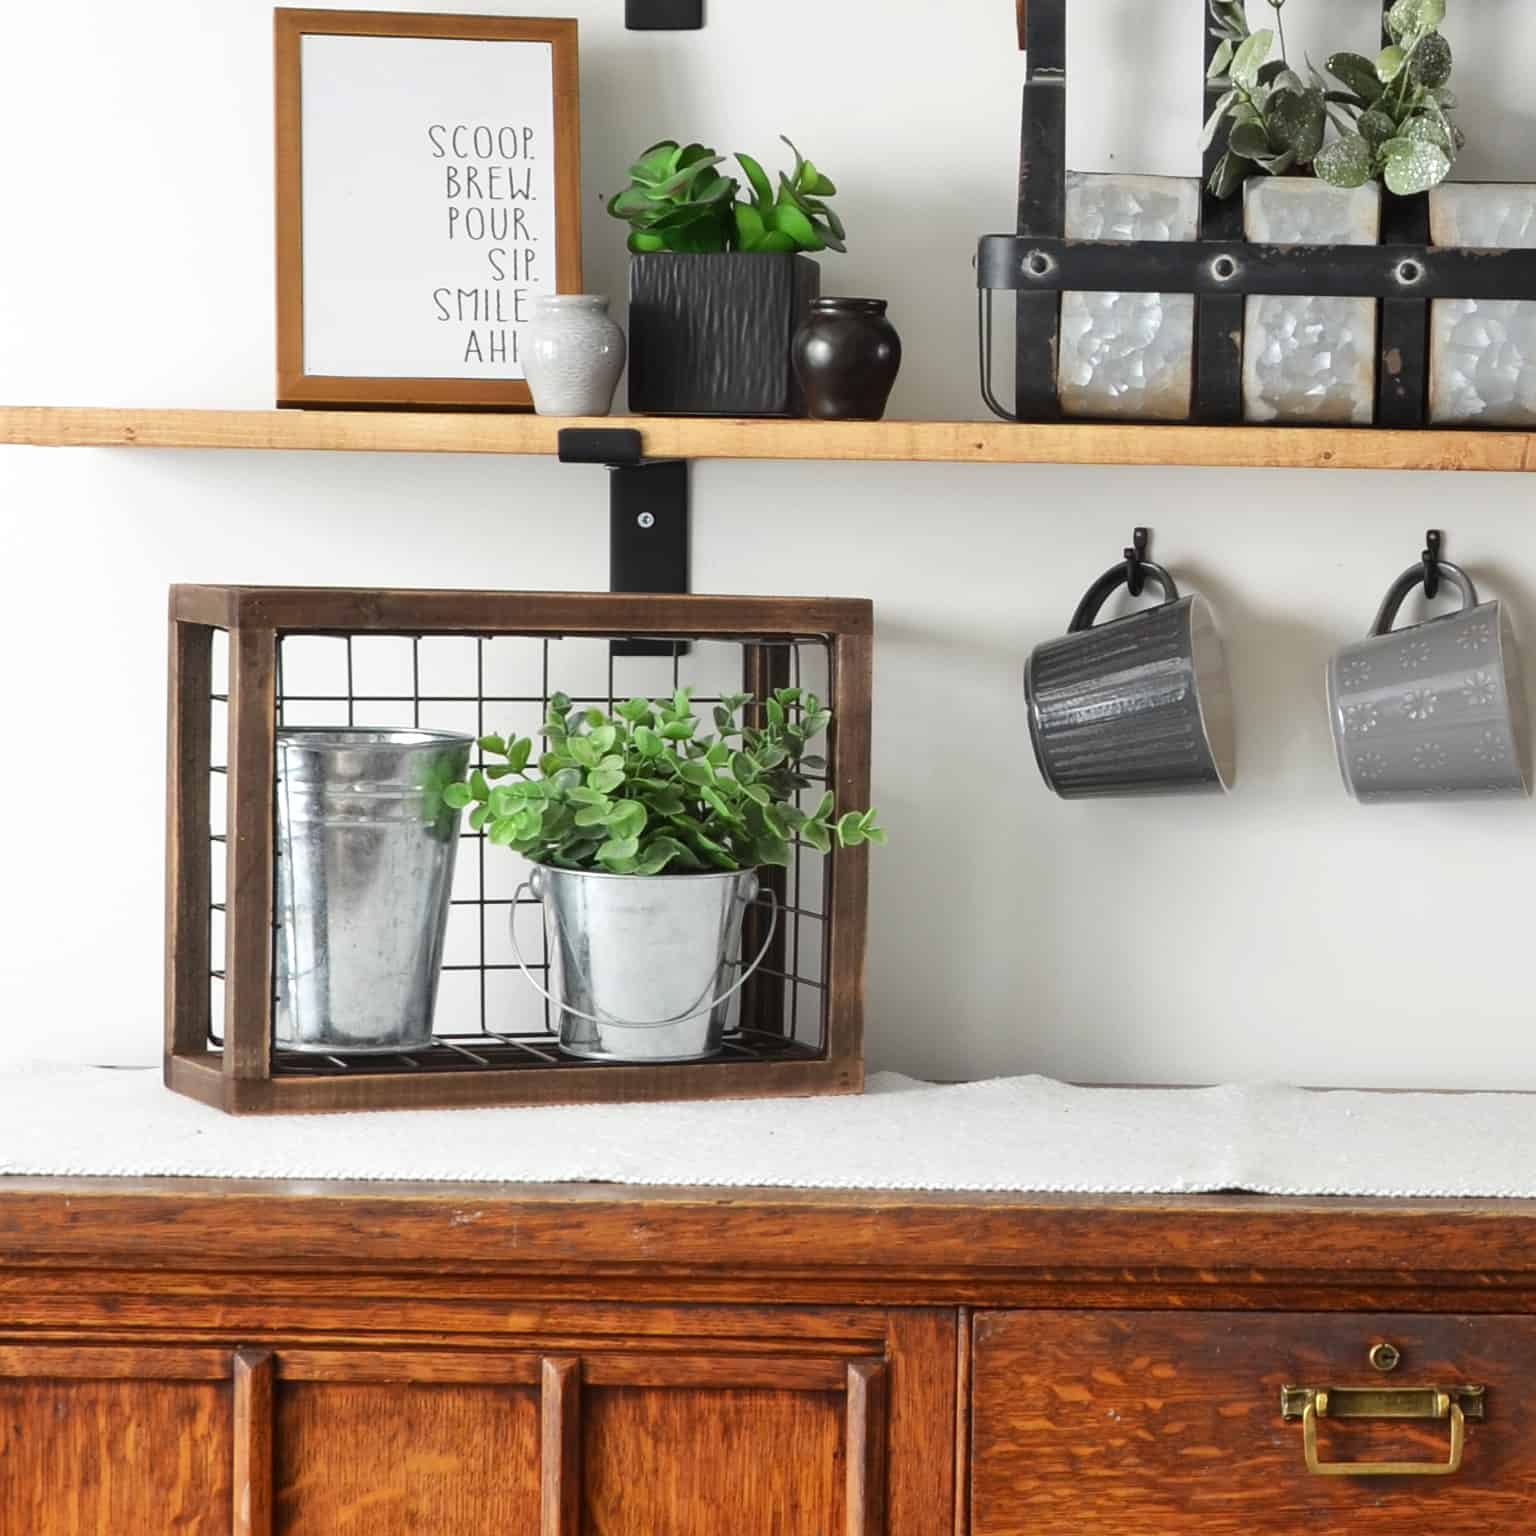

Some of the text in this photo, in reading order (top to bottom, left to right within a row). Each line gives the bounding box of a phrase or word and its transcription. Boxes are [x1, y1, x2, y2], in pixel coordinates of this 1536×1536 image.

[428, 124, 536, 161] SCOOP.
[446, 165, 538, 202] BREW.
[447, 206, 539, 242] POUR.
[487, 247, 540, 283] SIP.
